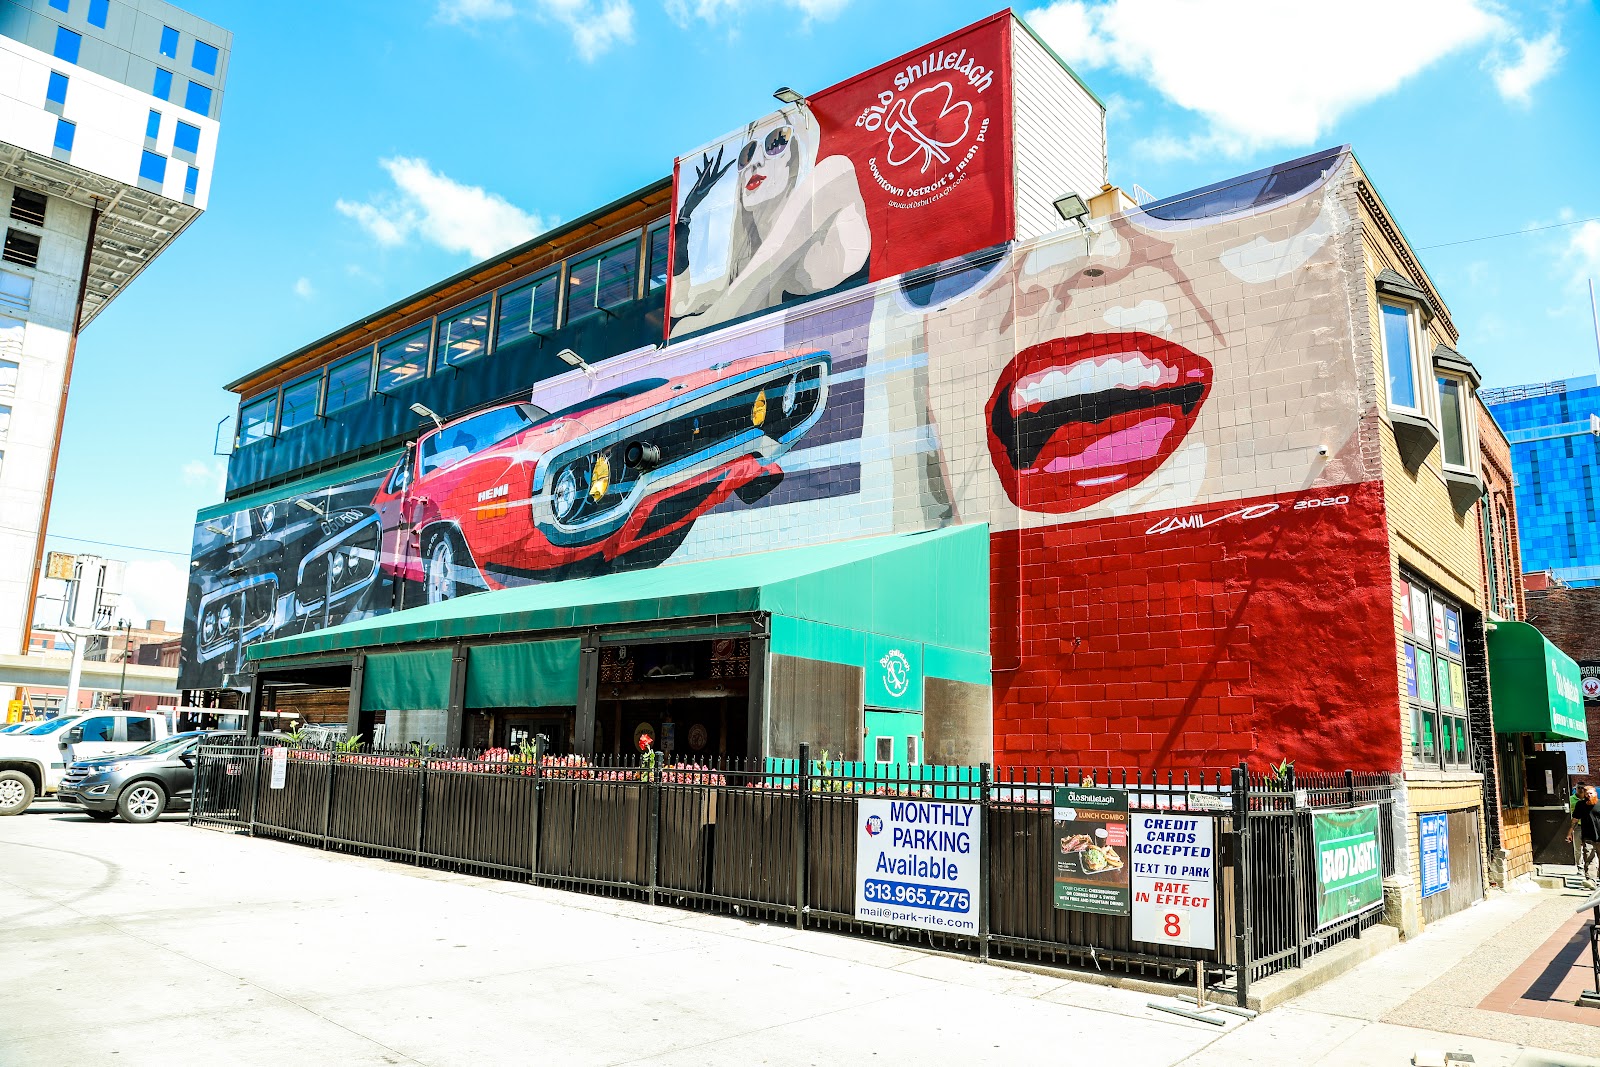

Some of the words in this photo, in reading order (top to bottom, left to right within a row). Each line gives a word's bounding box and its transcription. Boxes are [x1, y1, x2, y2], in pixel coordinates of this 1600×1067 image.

[477, 483, 509, 502] HEMI
[1294, 495, 1350, 511] 2020
[890, 801, 973, 827] MONTHLY
[1144, 818, 1198, 831] CREDIT
[893, 827, 970, 854] PARKING
[1146, 831, 1197, 844] CARDS
[1134, 843, 1211, 858] ACCEPTED
[875, 851, 959, 881] Available
[1134, 862, 1160, 875] TEXT
[1164, 864, 1177, 875] TO
[1181, 866, 1210, 878] PARK
[1321, 847, 1348, 884] BUD
[1348, 840, 1376, 876] LIGHT
[865, 882, 969, 910] 313.965.7275
[1154, 881, 1190, 895] RATE
[1135, 892, 1150, 903] IN
[1156, 894, 1210, 908] EFFECT
[860, 906, 974, 929] mail@park-rite.com
[1163, 913, 1181, 937] 8
